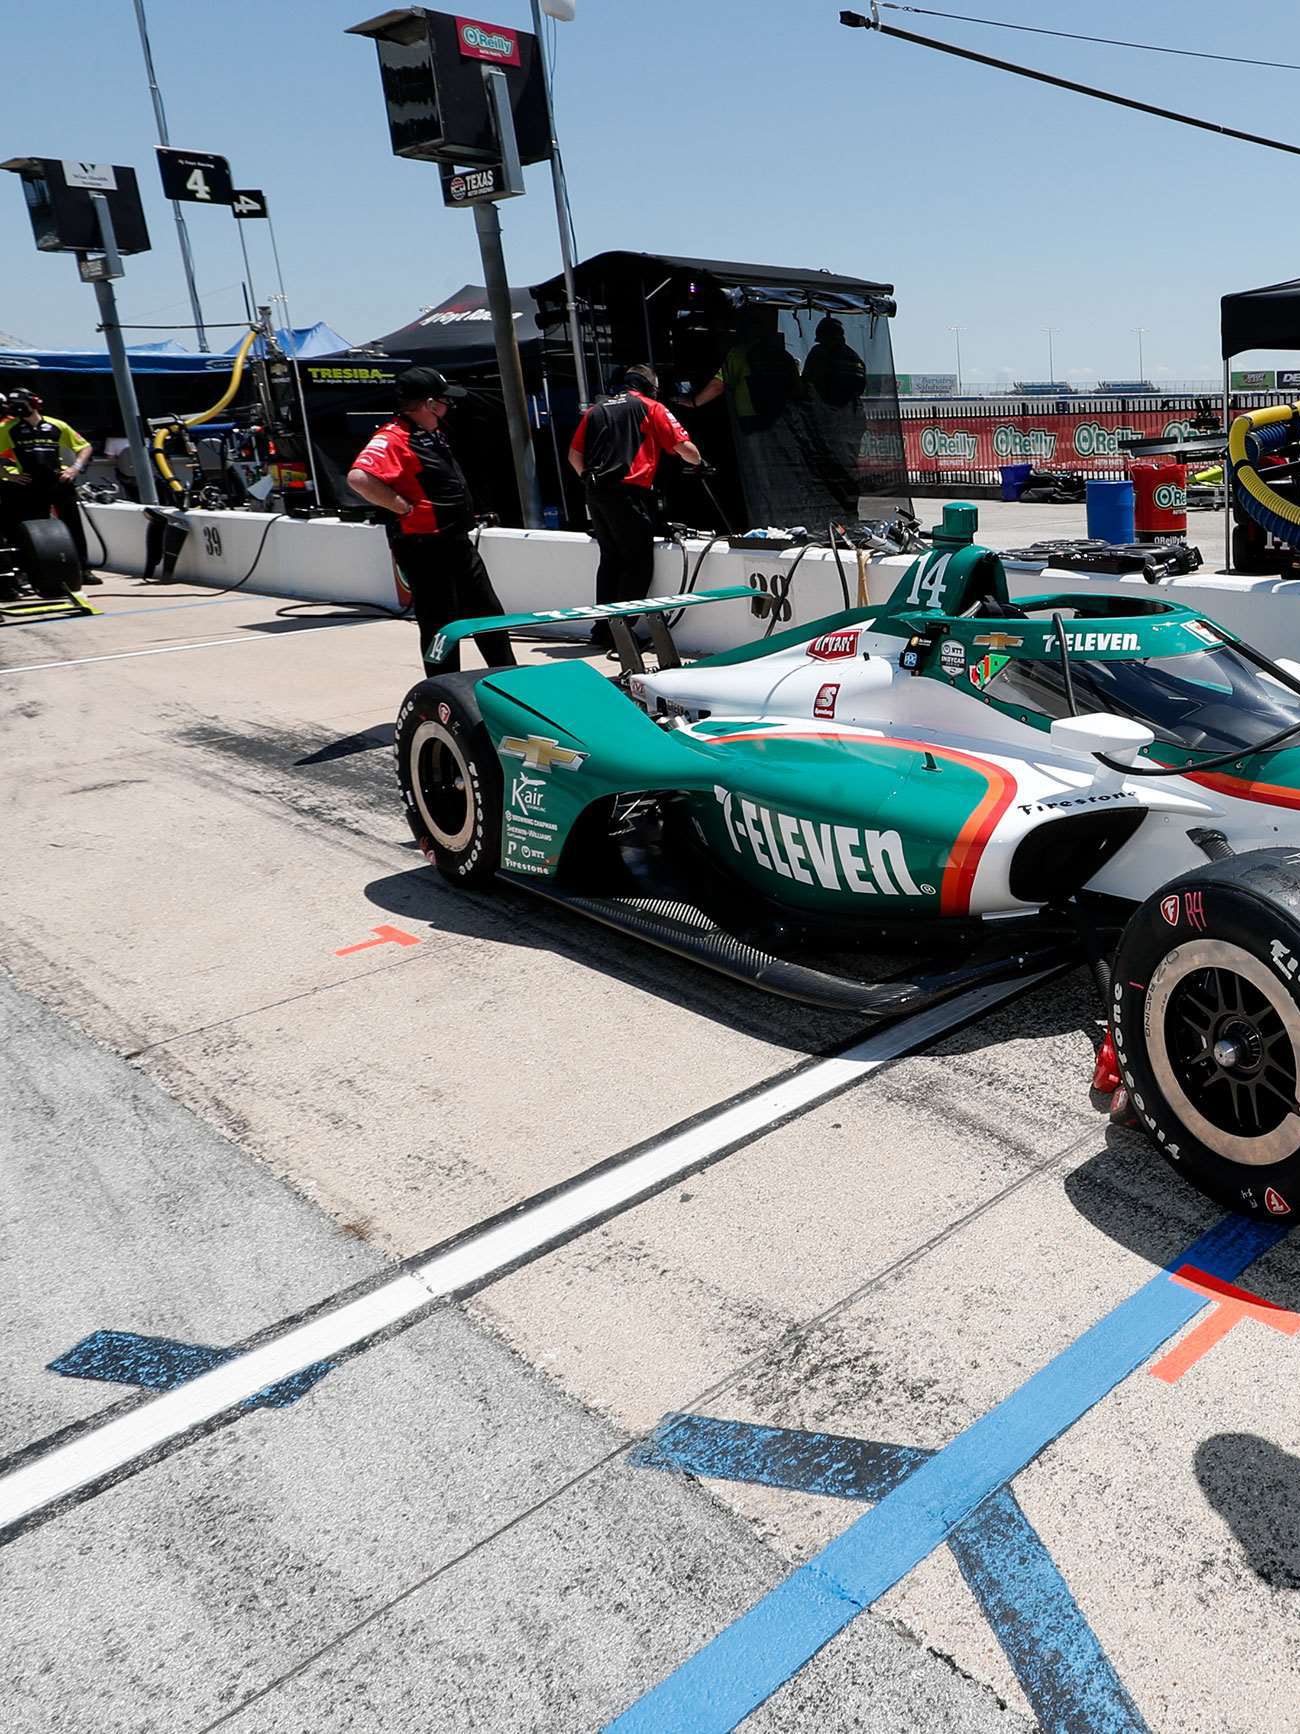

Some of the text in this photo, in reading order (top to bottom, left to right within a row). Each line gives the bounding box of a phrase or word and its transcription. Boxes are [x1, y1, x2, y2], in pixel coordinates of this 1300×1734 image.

[463, 27, 512, 54] O'Reilly
[187, 168, 211, 199] 4
[465, 170, 493, 190] TEXAS
[234, 195, 261, 213] 4
[307, 367, 382, 380] TRESIBA
[921, 428, 976, 460] O'Reilly
[993, 427, 1055, 458] O'Reilly
[203, 527, 222, 557] 39
[906, 552, 952, 608] 14
[814, 634, 855, 655] bryant
[941, 655, 965, 664] INDYCAR
[1017, 789, 1137, 816] Firestone
[504, 857, 550, 875] Firestone
